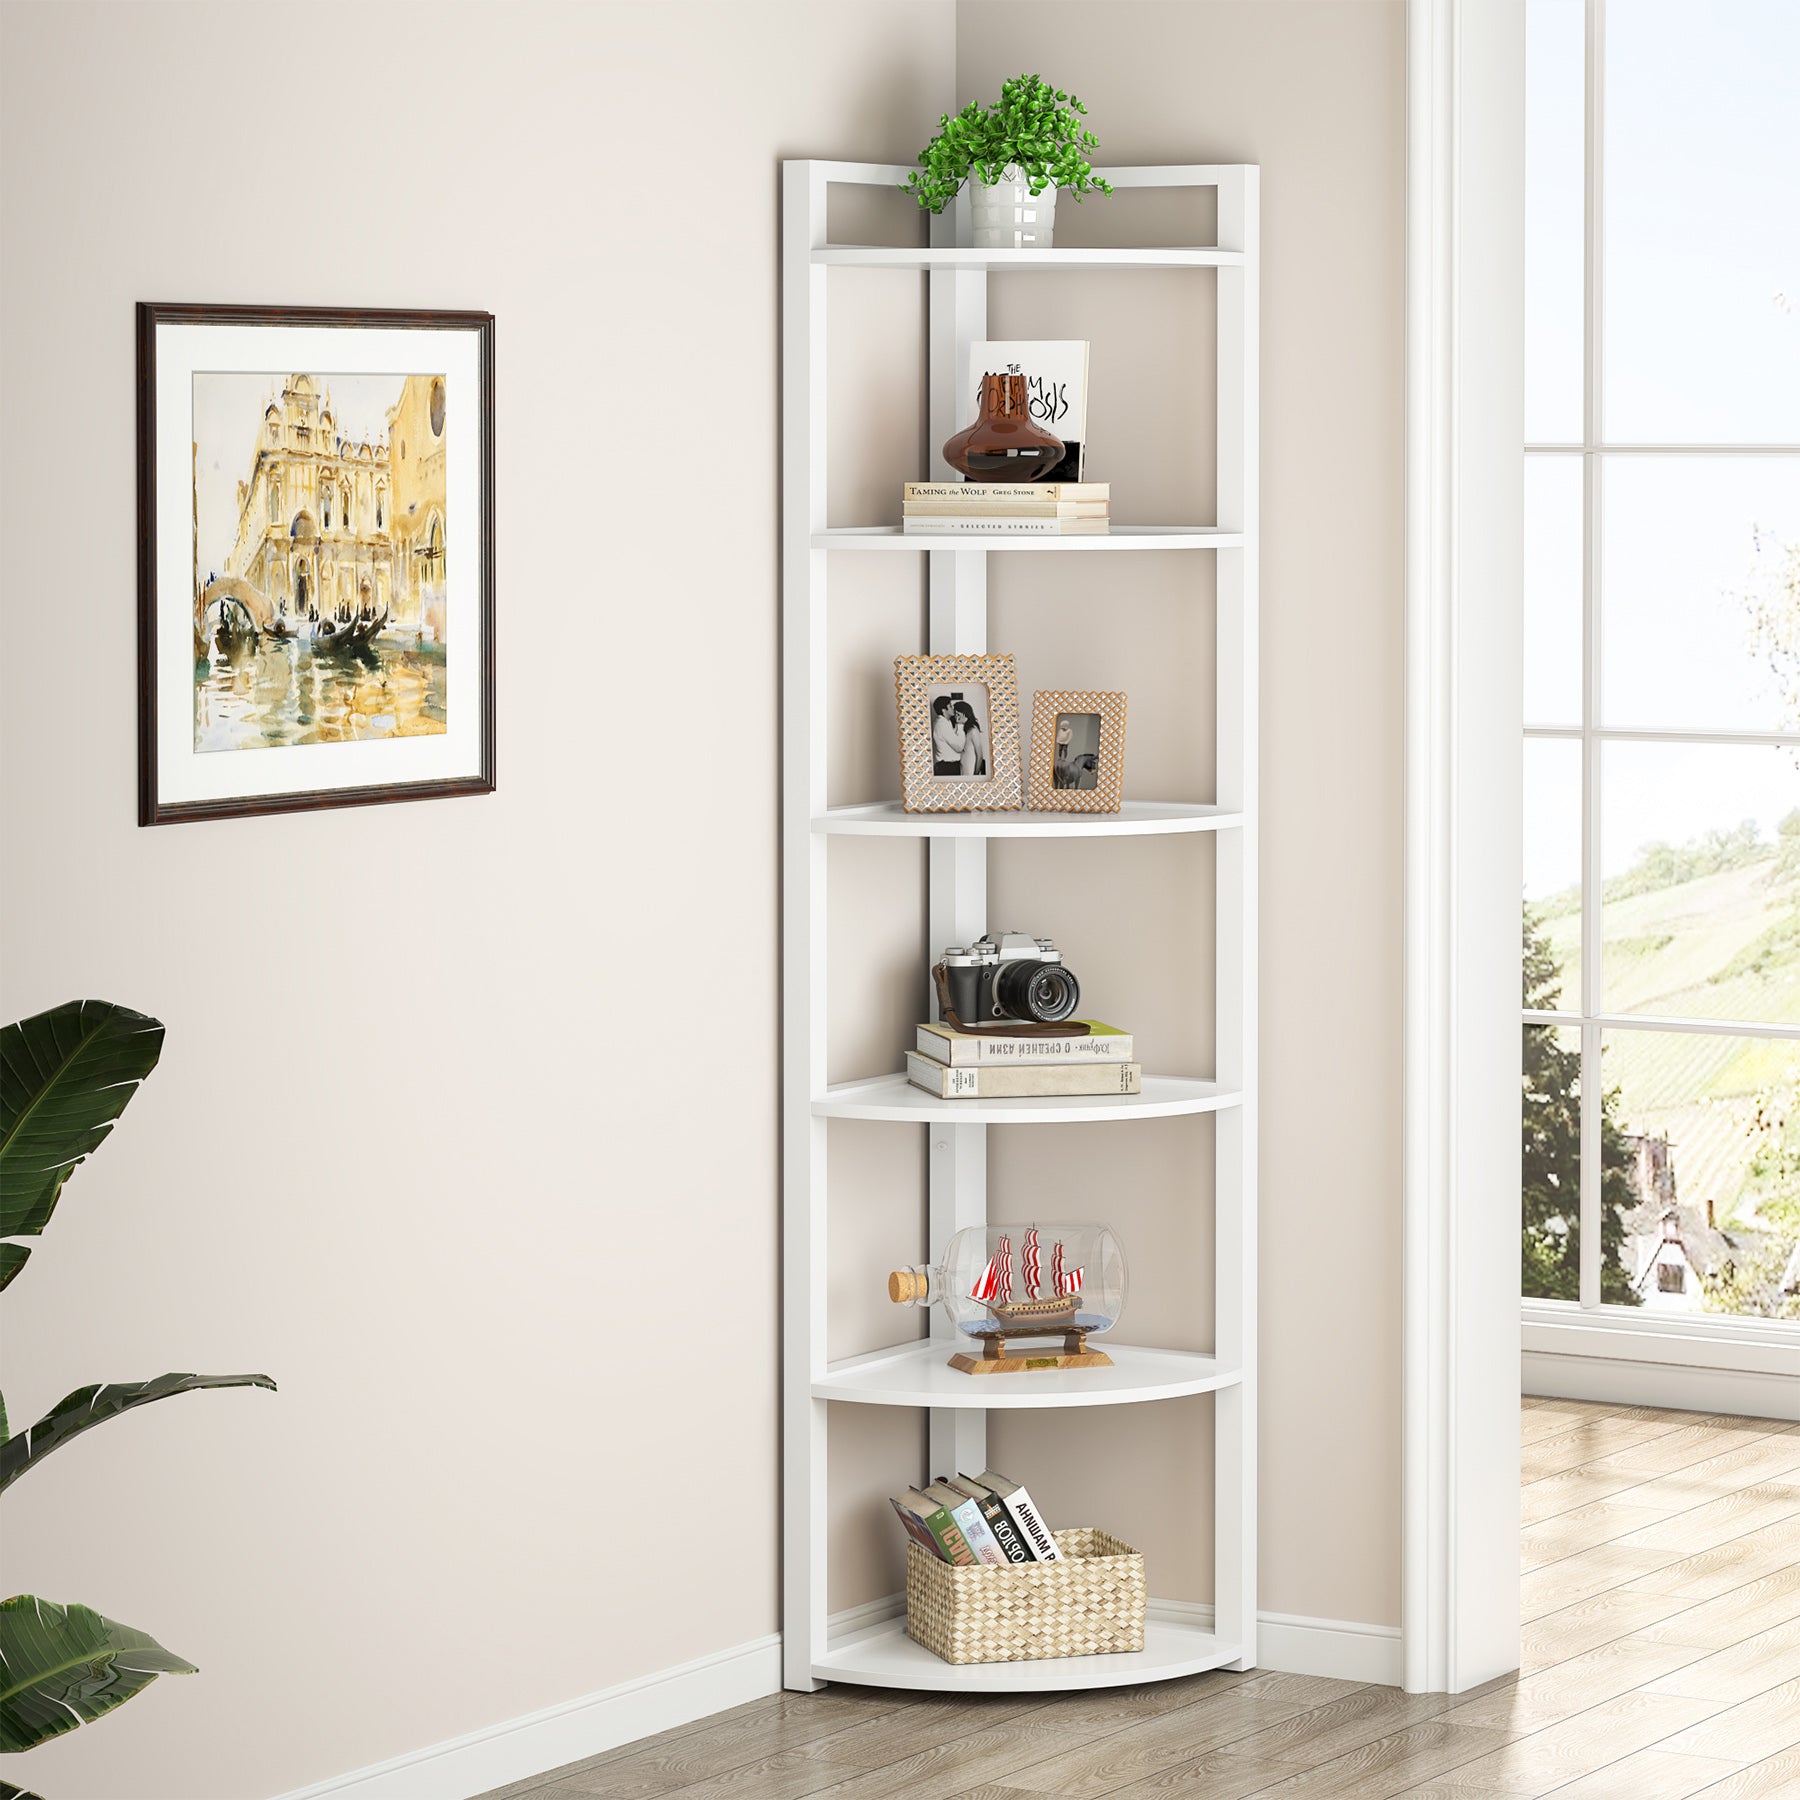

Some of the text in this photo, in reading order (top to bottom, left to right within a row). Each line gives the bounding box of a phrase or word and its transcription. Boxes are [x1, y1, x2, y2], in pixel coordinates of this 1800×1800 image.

[1006, 364, 1021, 374] THE
[910, 487, 947, 495] TAMING
[960, 487, 987, 496] WOLF
